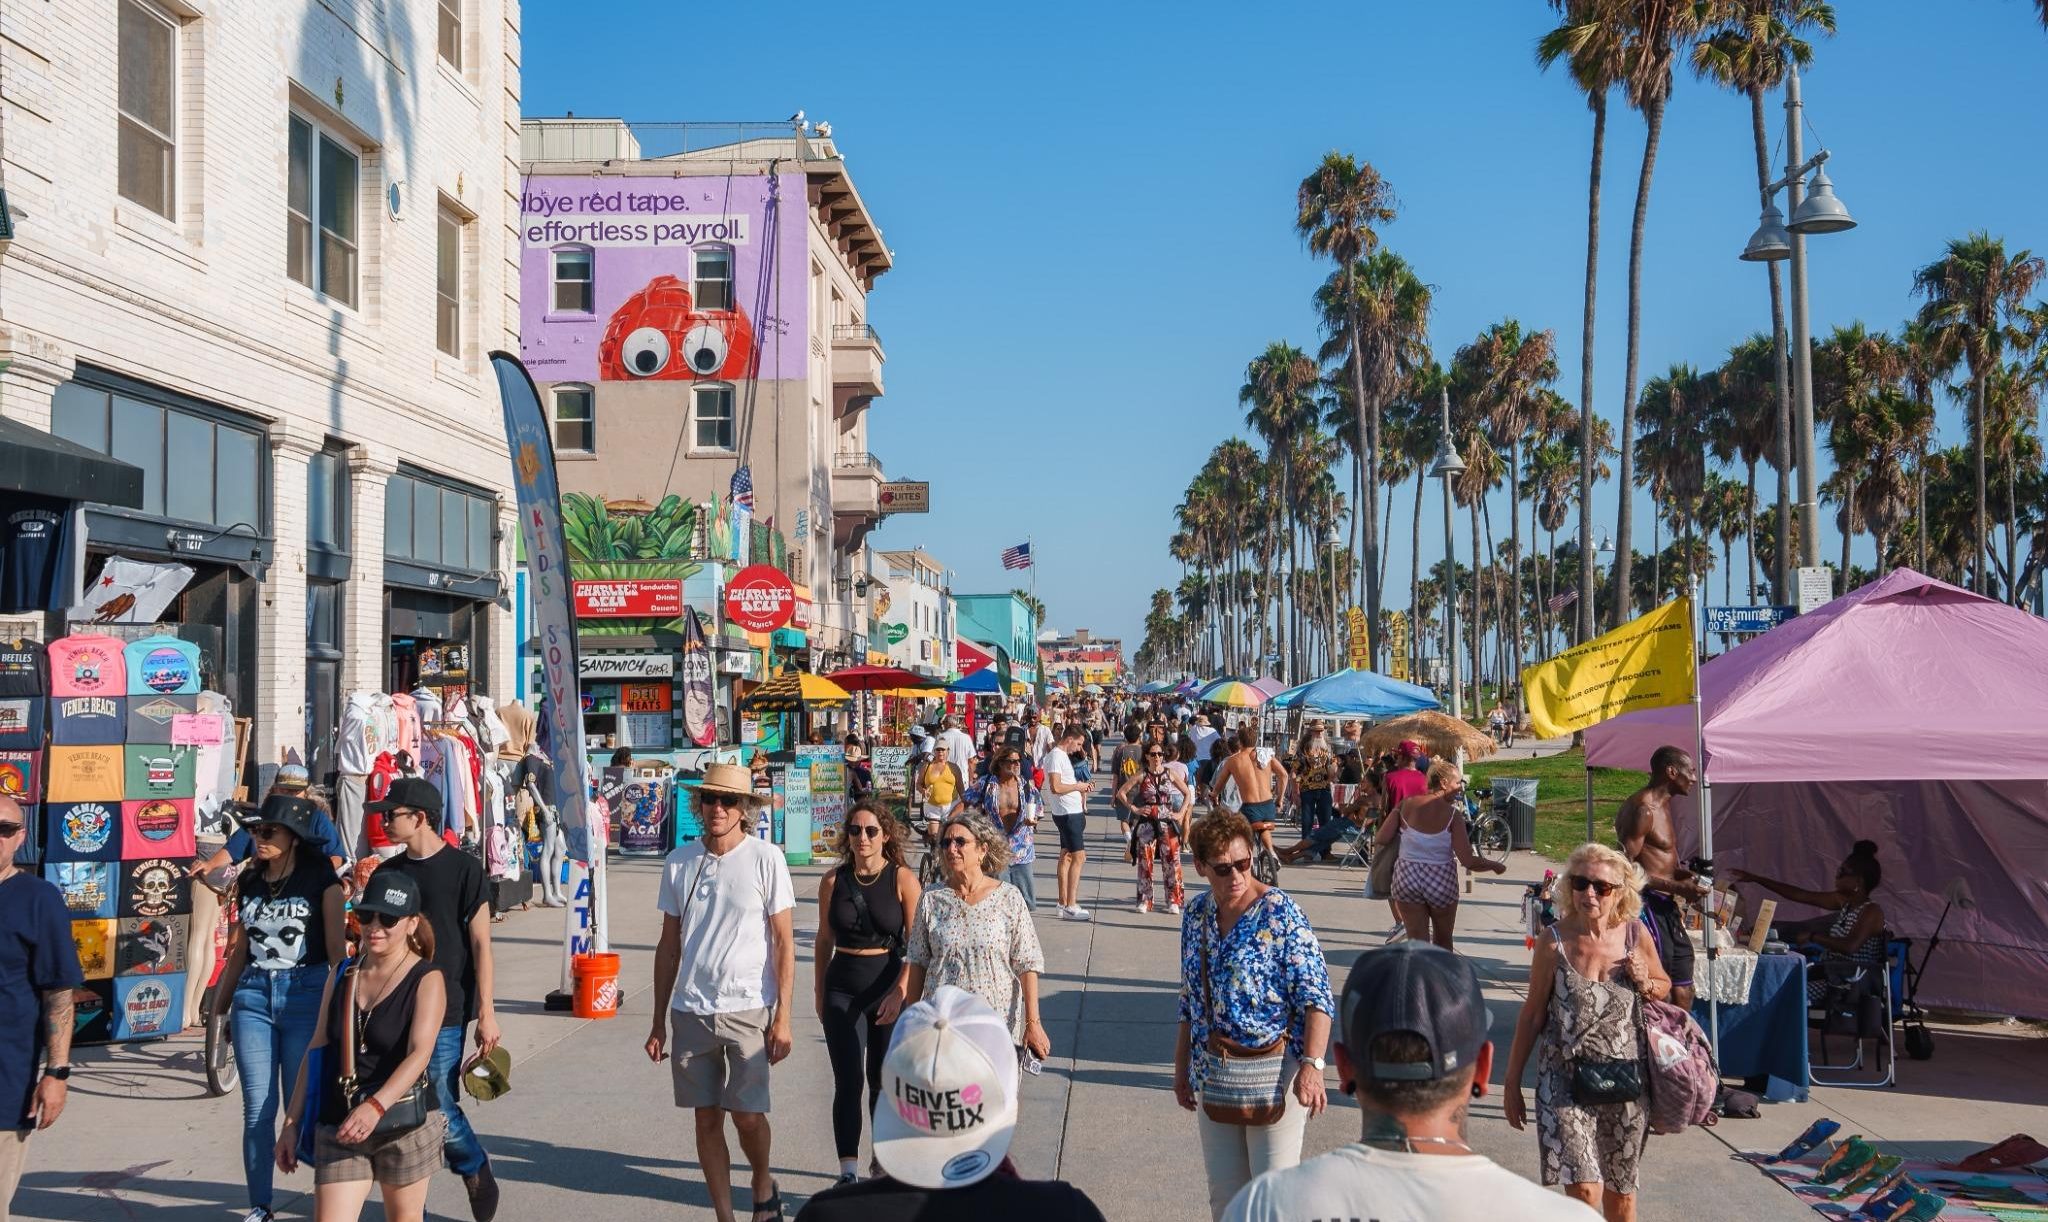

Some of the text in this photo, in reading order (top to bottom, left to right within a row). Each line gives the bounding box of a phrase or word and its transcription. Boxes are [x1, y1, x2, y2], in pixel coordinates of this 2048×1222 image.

[579, 191, 622, 212] red
[629, 193, 690, 215] tape.
[527, 219, 744, 245] effortless payroll.
[537, 358, 567, 366] platform
[533, 509, 551, 597] KIDS
[640, 583, 678, 591] Sandwiches
[747, 619, 774, 630] VENICE
[1, 653, 33, 663] BEETLES
[579, 659, 647, 674] SANDWICH
[1600, 658, 1620, 668] WIGS
[1564, 668, 1662, 703] HAIR GROWTH PRODUCTS
[61, 698, 117, 719] VENICE BEACH
[626, 701, 661, 712] MEATS
[9, 752, 32, 760] BEACH
[64, 803, 111, 820] VENICE
[132, 860, 181, 879] VENICE BEACH
[895, 1076, 962, 1110] I GIVE
[928, 1102, 984, 1132] FUX
